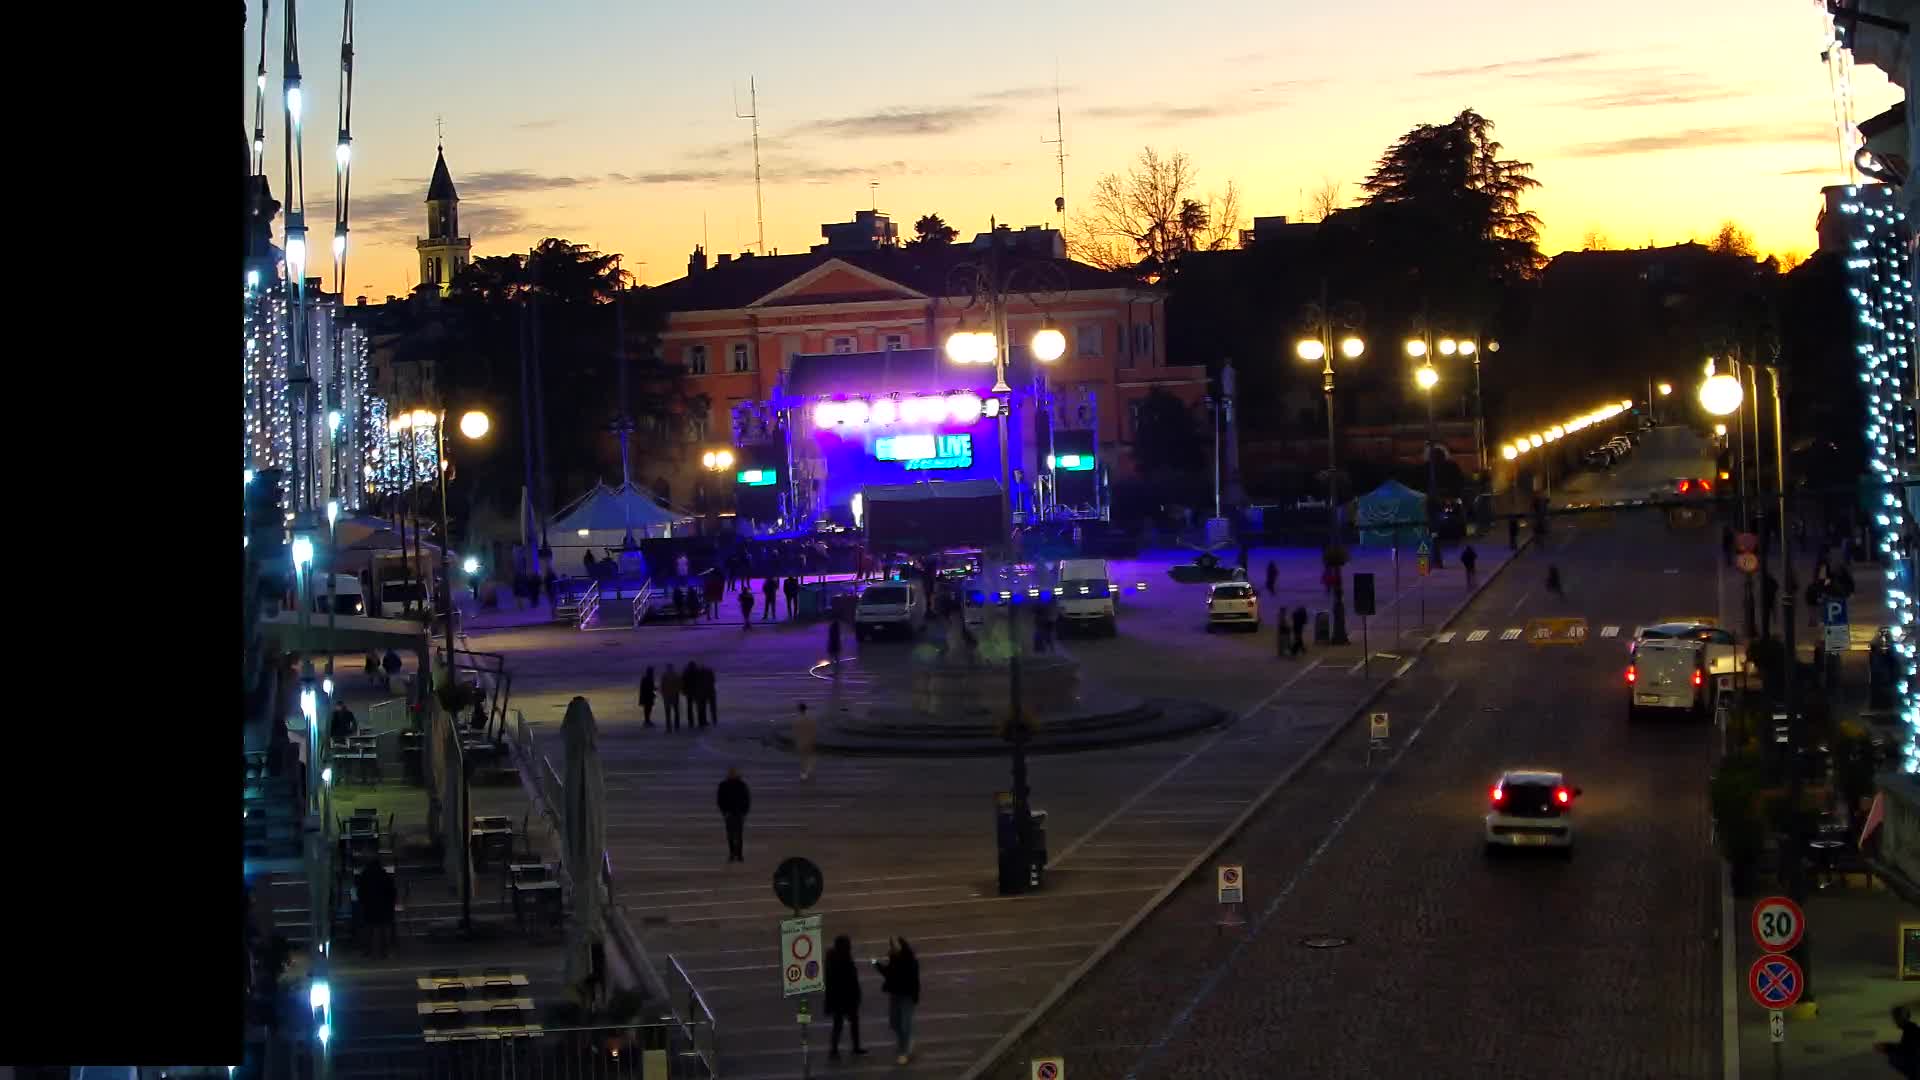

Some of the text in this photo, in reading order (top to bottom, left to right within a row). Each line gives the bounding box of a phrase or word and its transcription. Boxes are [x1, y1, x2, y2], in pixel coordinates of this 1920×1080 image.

[938, 434, 972, 457] LIVE
[1827, 602, 1842, 622] P
[1763, 912, 1792, 938] 30
